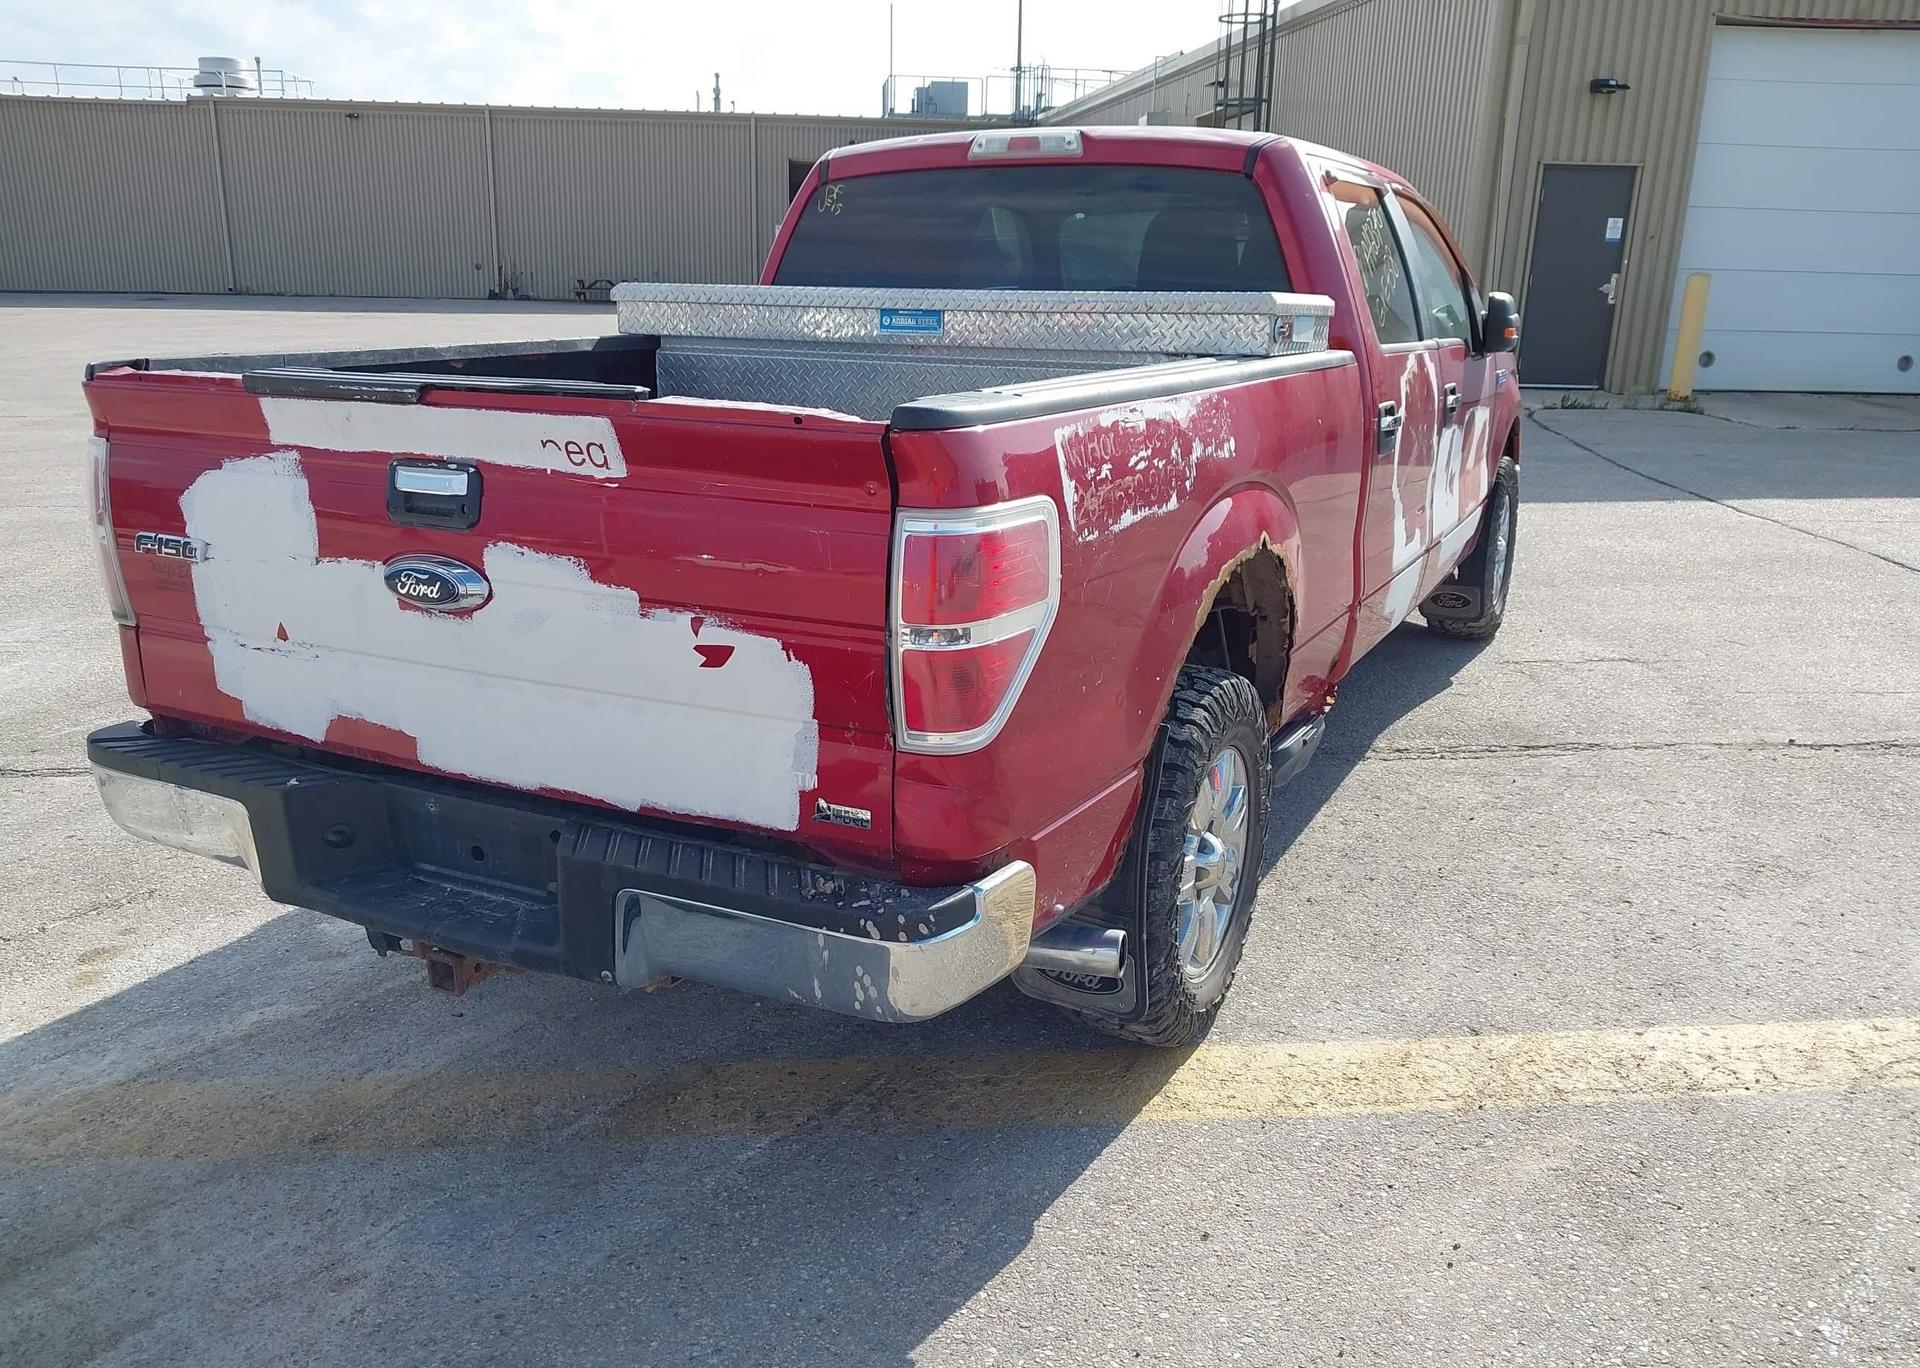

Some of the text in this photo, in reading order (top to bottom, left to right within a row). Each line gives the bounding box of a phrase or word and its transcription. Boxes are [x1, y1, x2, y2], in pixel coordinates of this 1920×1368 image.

[396, 570, 441, 599] Ford
[1437, 593, 1465, 608] Ford
[1046, 968, 1102, 989] ord
